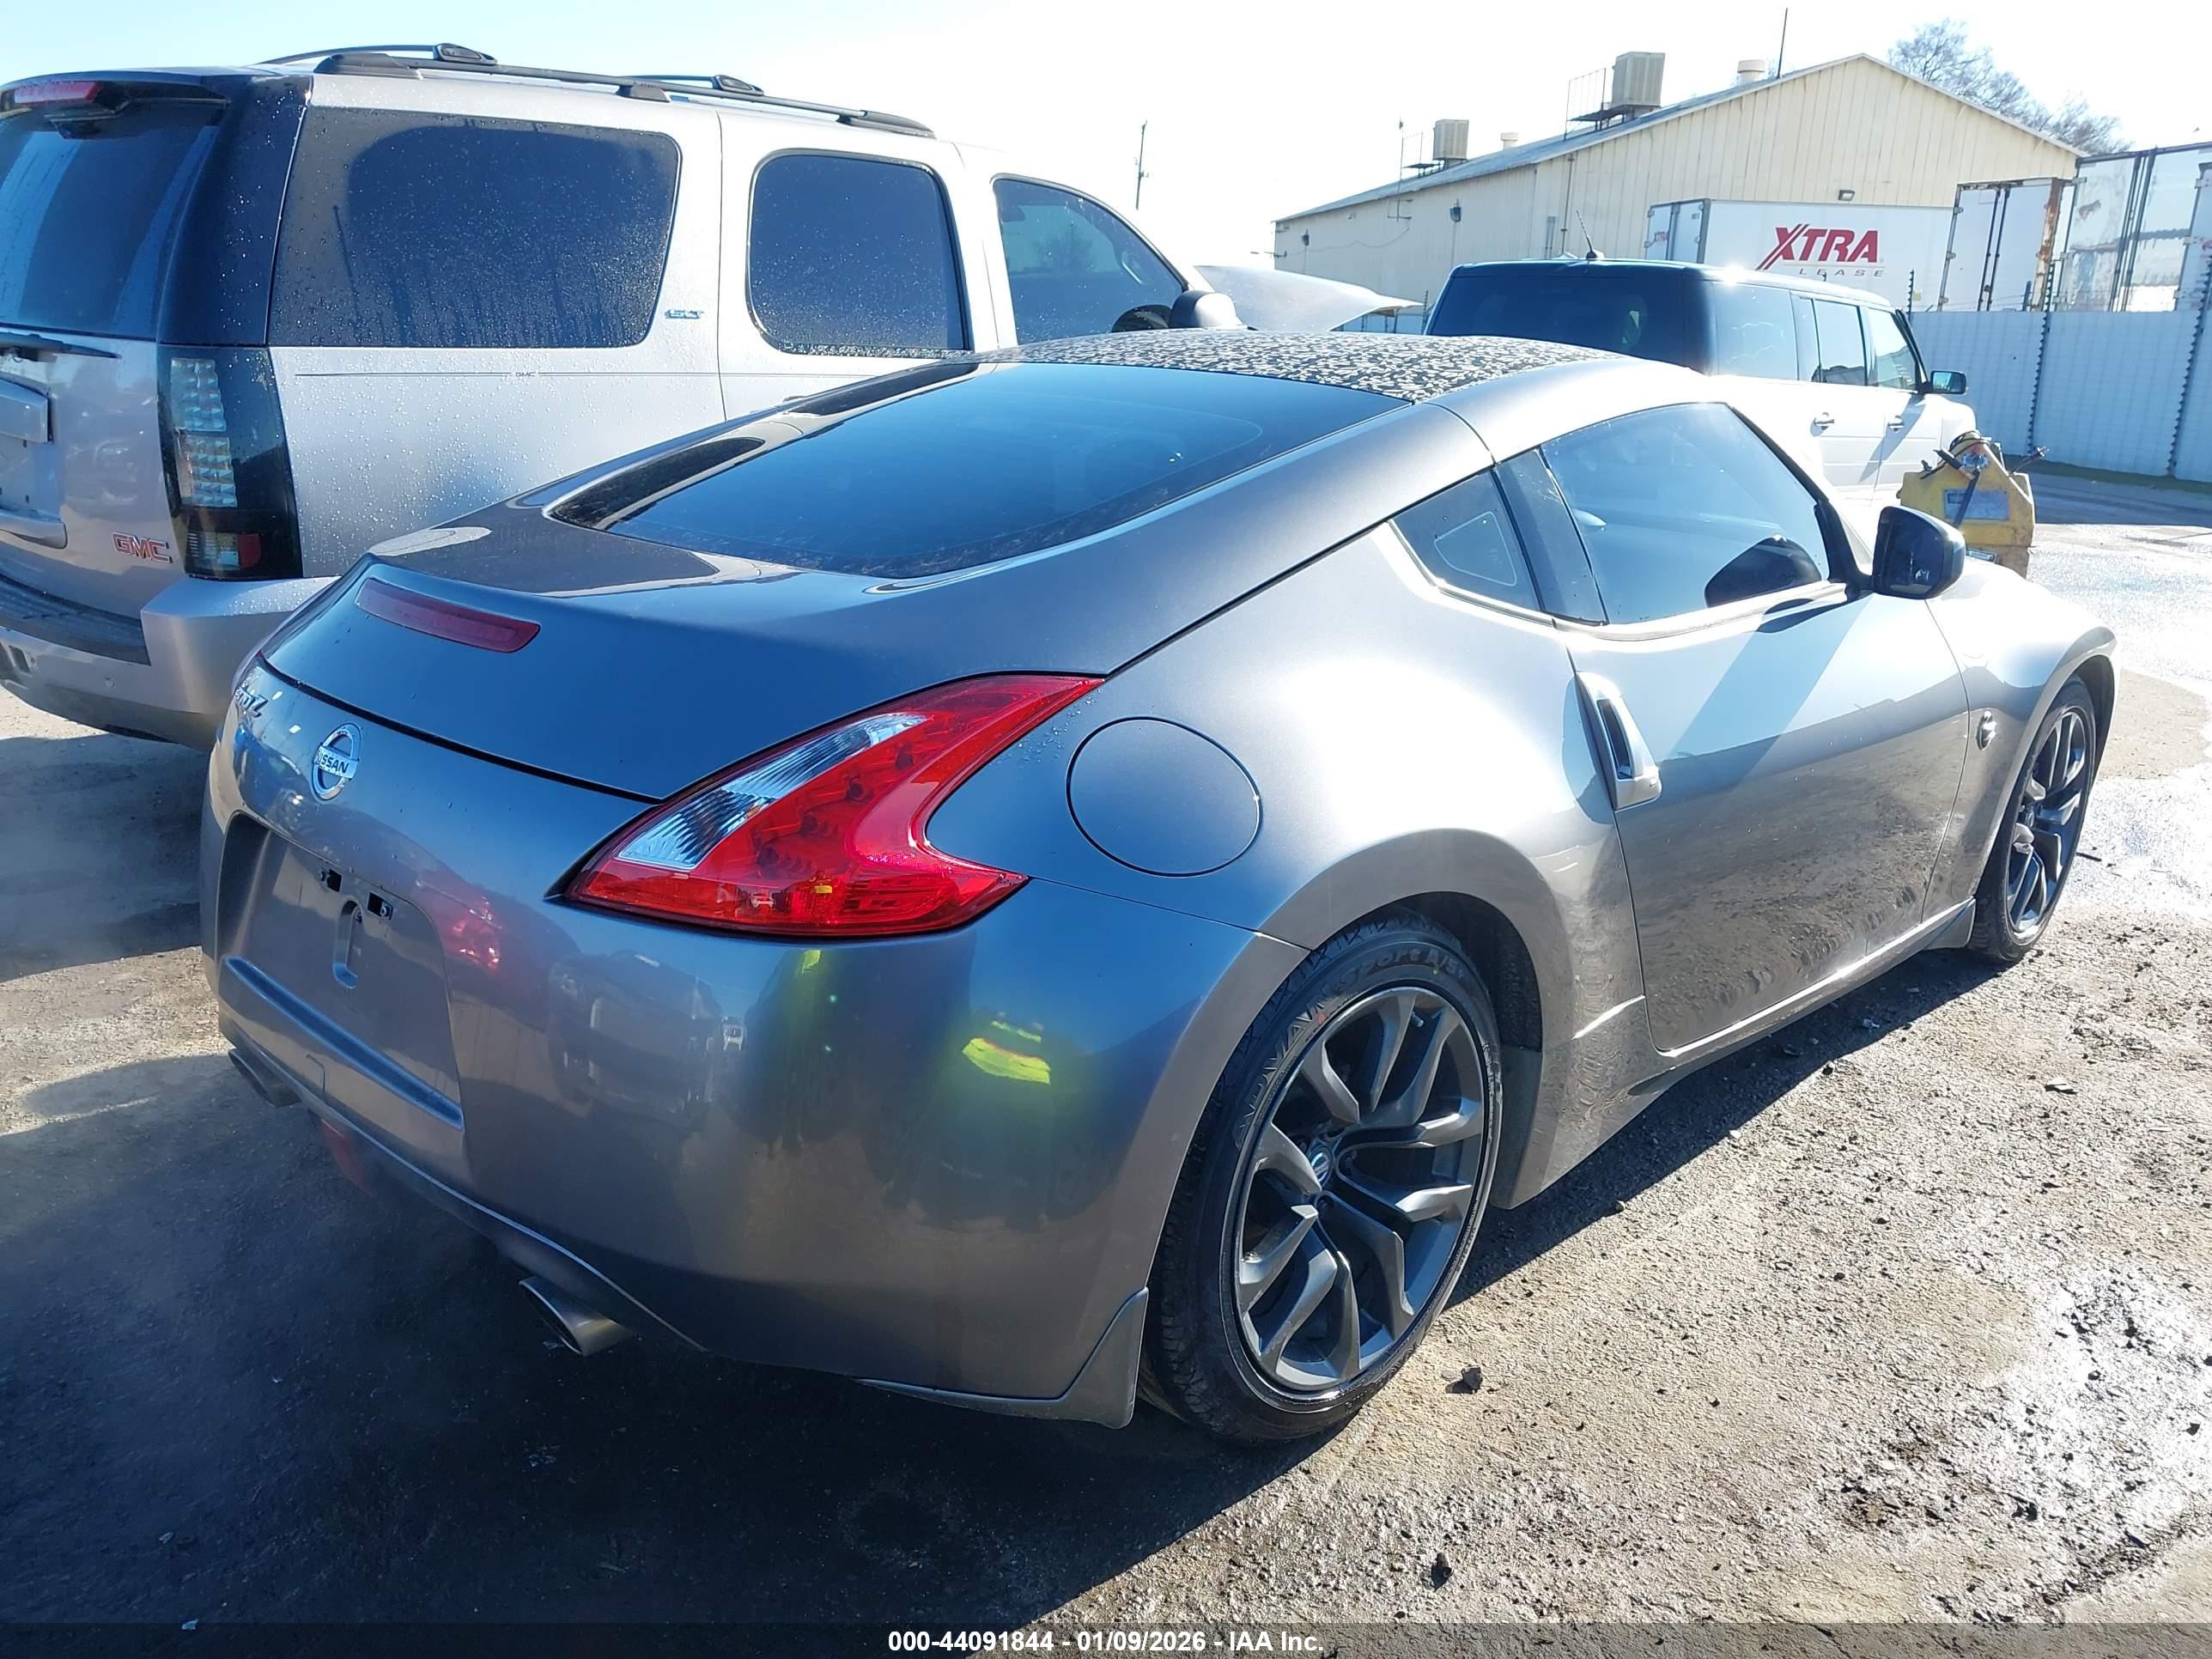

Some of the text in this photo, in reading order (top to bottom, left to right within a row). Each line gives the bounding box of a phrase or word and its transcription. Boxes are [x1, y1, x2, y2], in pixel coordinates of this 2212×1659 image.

[1756, 224, 1878, 271] XTRA
[1799, 268, 1884, 277] LEASE
[112, 532, 172, 563] GMC
[316, 746, 350, 774] NISSAN
